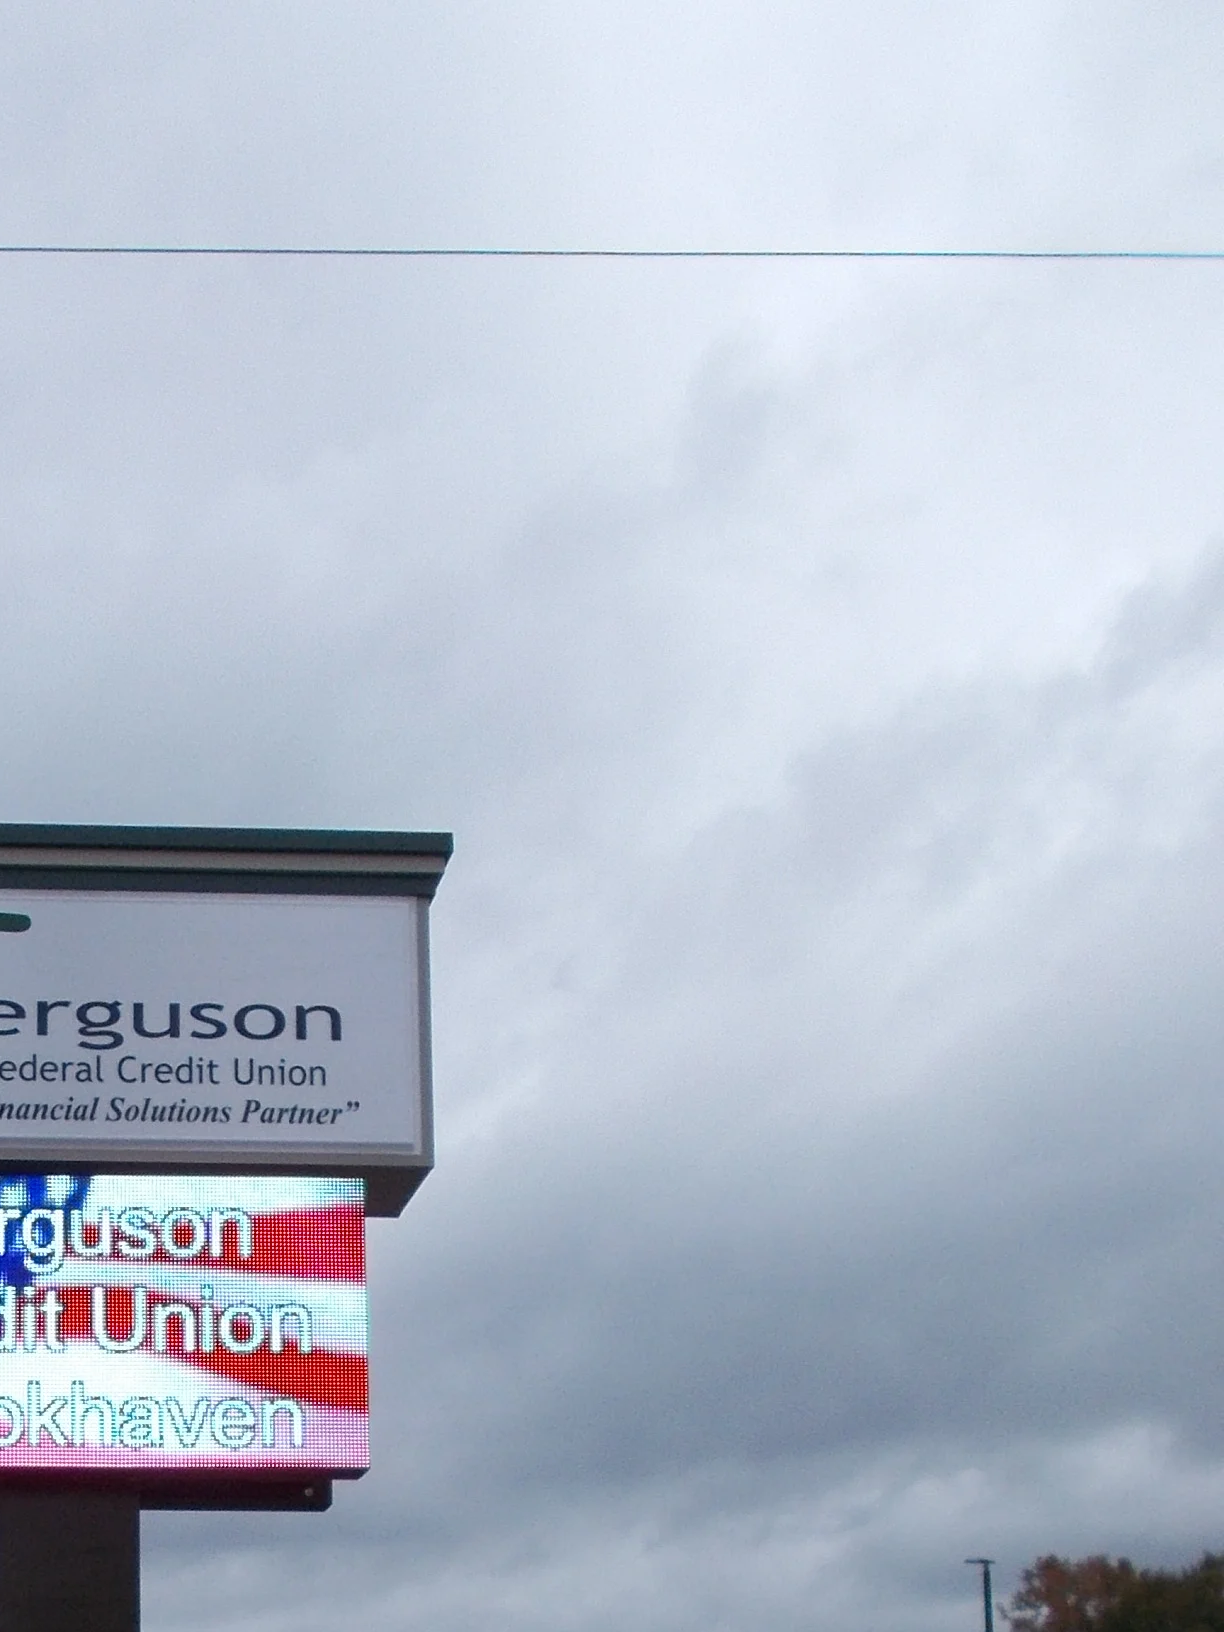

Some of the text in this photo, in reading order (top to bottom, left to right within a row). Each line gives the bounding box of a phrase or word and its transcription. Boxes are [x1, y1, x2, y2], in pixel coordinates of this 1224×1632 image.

[117, 1056, 218, 1085] Credit
[233, 1059, 327, 1087] Union
[105, 1097, 231, 1125] Solutions
[90, 1283, 314, 1355] Union
